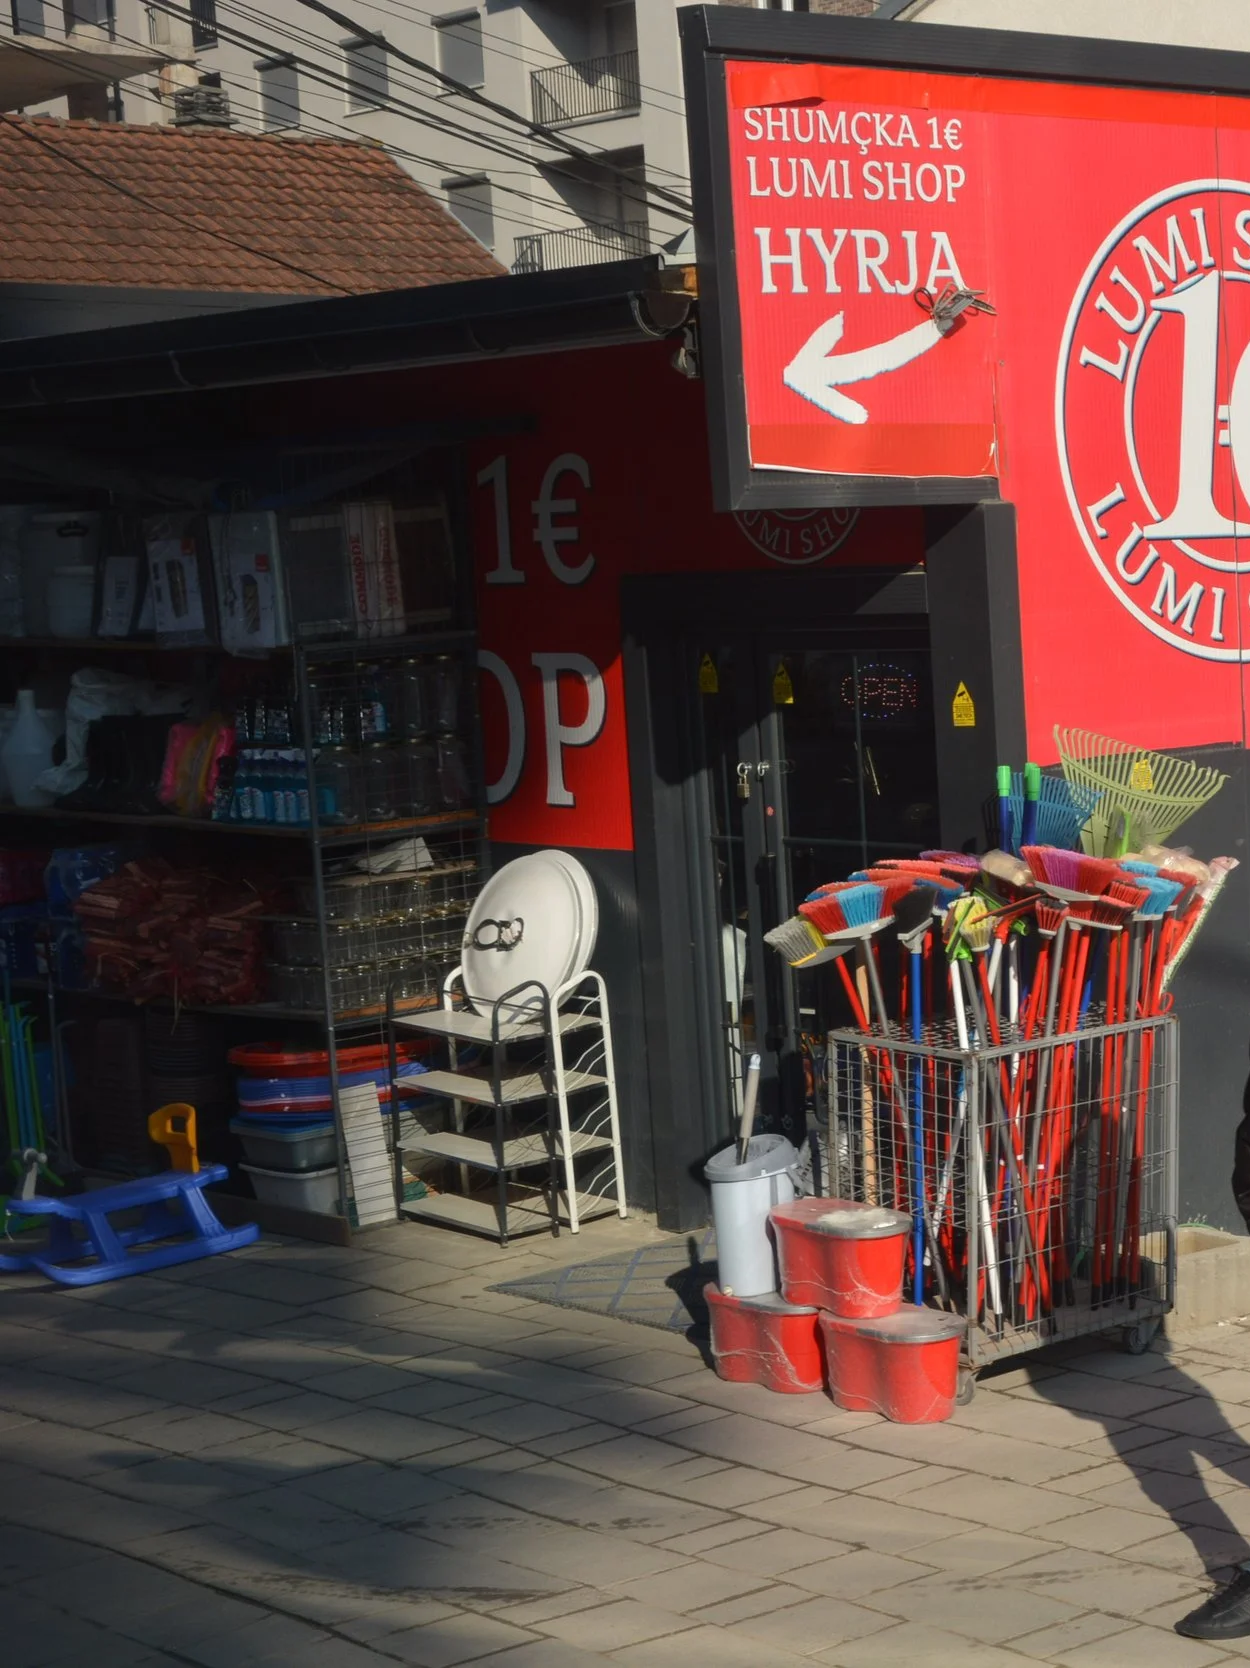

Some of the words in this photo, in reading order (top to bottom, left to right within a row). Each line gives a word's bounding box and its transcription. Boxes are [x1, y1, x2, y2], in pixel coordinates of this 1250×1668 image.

[745, 107, 920, 155] SHUMÇKA
[927, 117, 963, 151] 1€
[746, 156, 853, 198] LUMI
[863, 160, 966, 203] SHOP
[754, 227, 964, 295] HYRJA
[1078, 207, 1217, 383] LUMI
[478, 453, 596, 585] 1€
[743, 510, 791, 554] UMI
[800, 507, 850, 554] SHO
[349, 532, 368, 615] COMMODE
[1086, 481, 1226, 642] LUMI
[841, 676, 917, 708] OPEN
